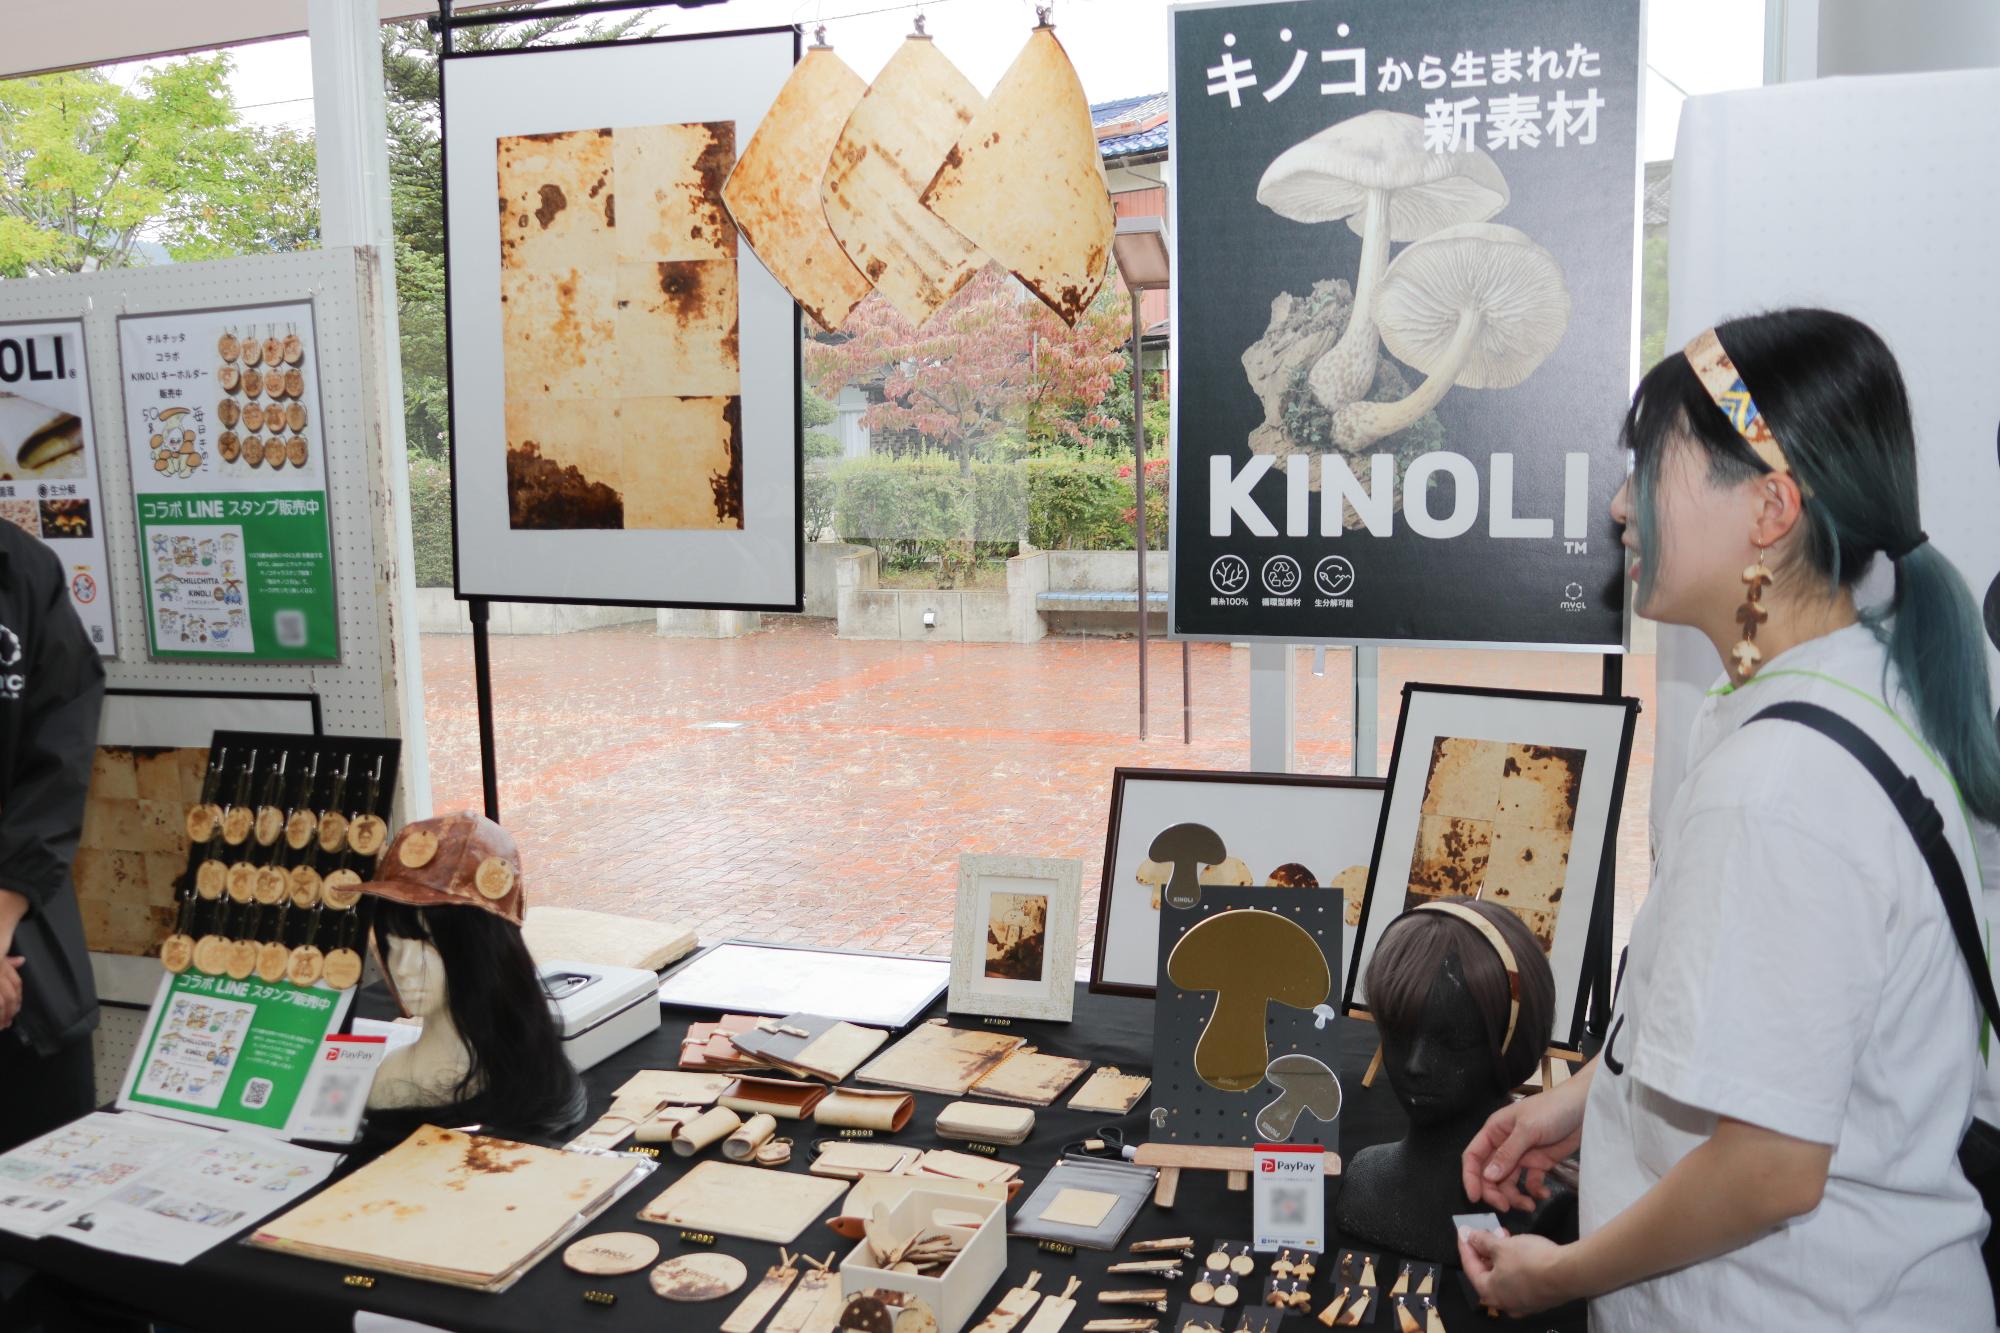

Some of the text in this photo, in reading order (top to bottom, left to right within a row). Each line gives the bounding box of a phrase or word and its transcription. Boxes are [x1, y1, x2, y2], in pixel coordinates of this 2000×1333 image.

[1422, 88, 1605, 155] 新素材
[155, 352, 180, 362] コラボ
[131, 370, 208, 381] KINOLI キーホルダー
[159, 389, 183, 399] 販売中
[1210, 451, 1590, 539] KINOLI
[144, 499, 319, 519] コラボ LINE スタンプ販売中
[1563, 541, 1588, 555] TM
[1314, 598, 1354, 608] 生分解可能
[179, 974, 331, 1011] コラボ LINE スタンプ販売中
[341, 1049, 375, 1061] PayPay
[1277, 1161, 1315, 1172] PayPay
